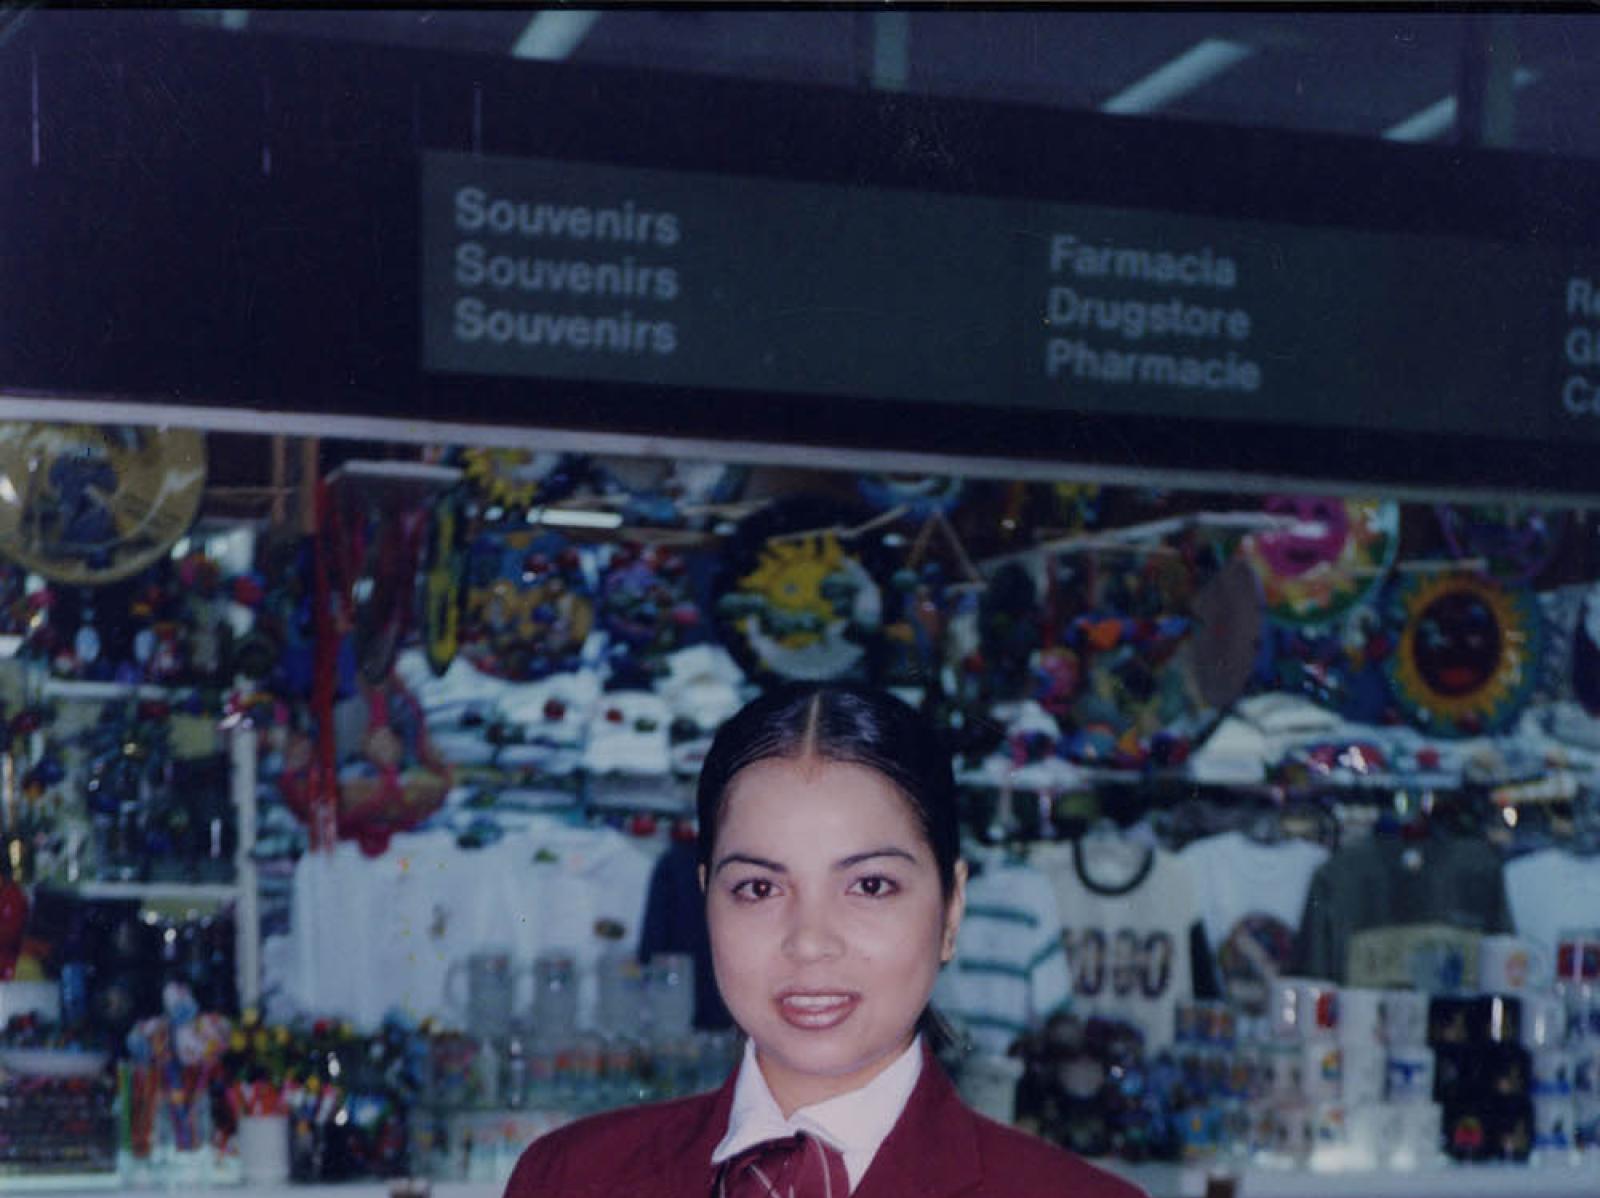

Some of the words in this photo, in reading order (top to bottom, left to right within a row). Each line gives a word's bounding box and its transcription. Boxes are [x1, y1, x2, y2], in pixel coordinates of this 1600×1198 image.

[456, 187, 679, 244] Souvenirs
[456, 243, 678, 298] Souvenirs
[1050, 234, 1237, 287] Farmacia
[456, 297, 677, 353] Souvenirs
[1049, 288, 1250, 339] Drugstore
[1047, 341, 1260, 391] Pharmacie
